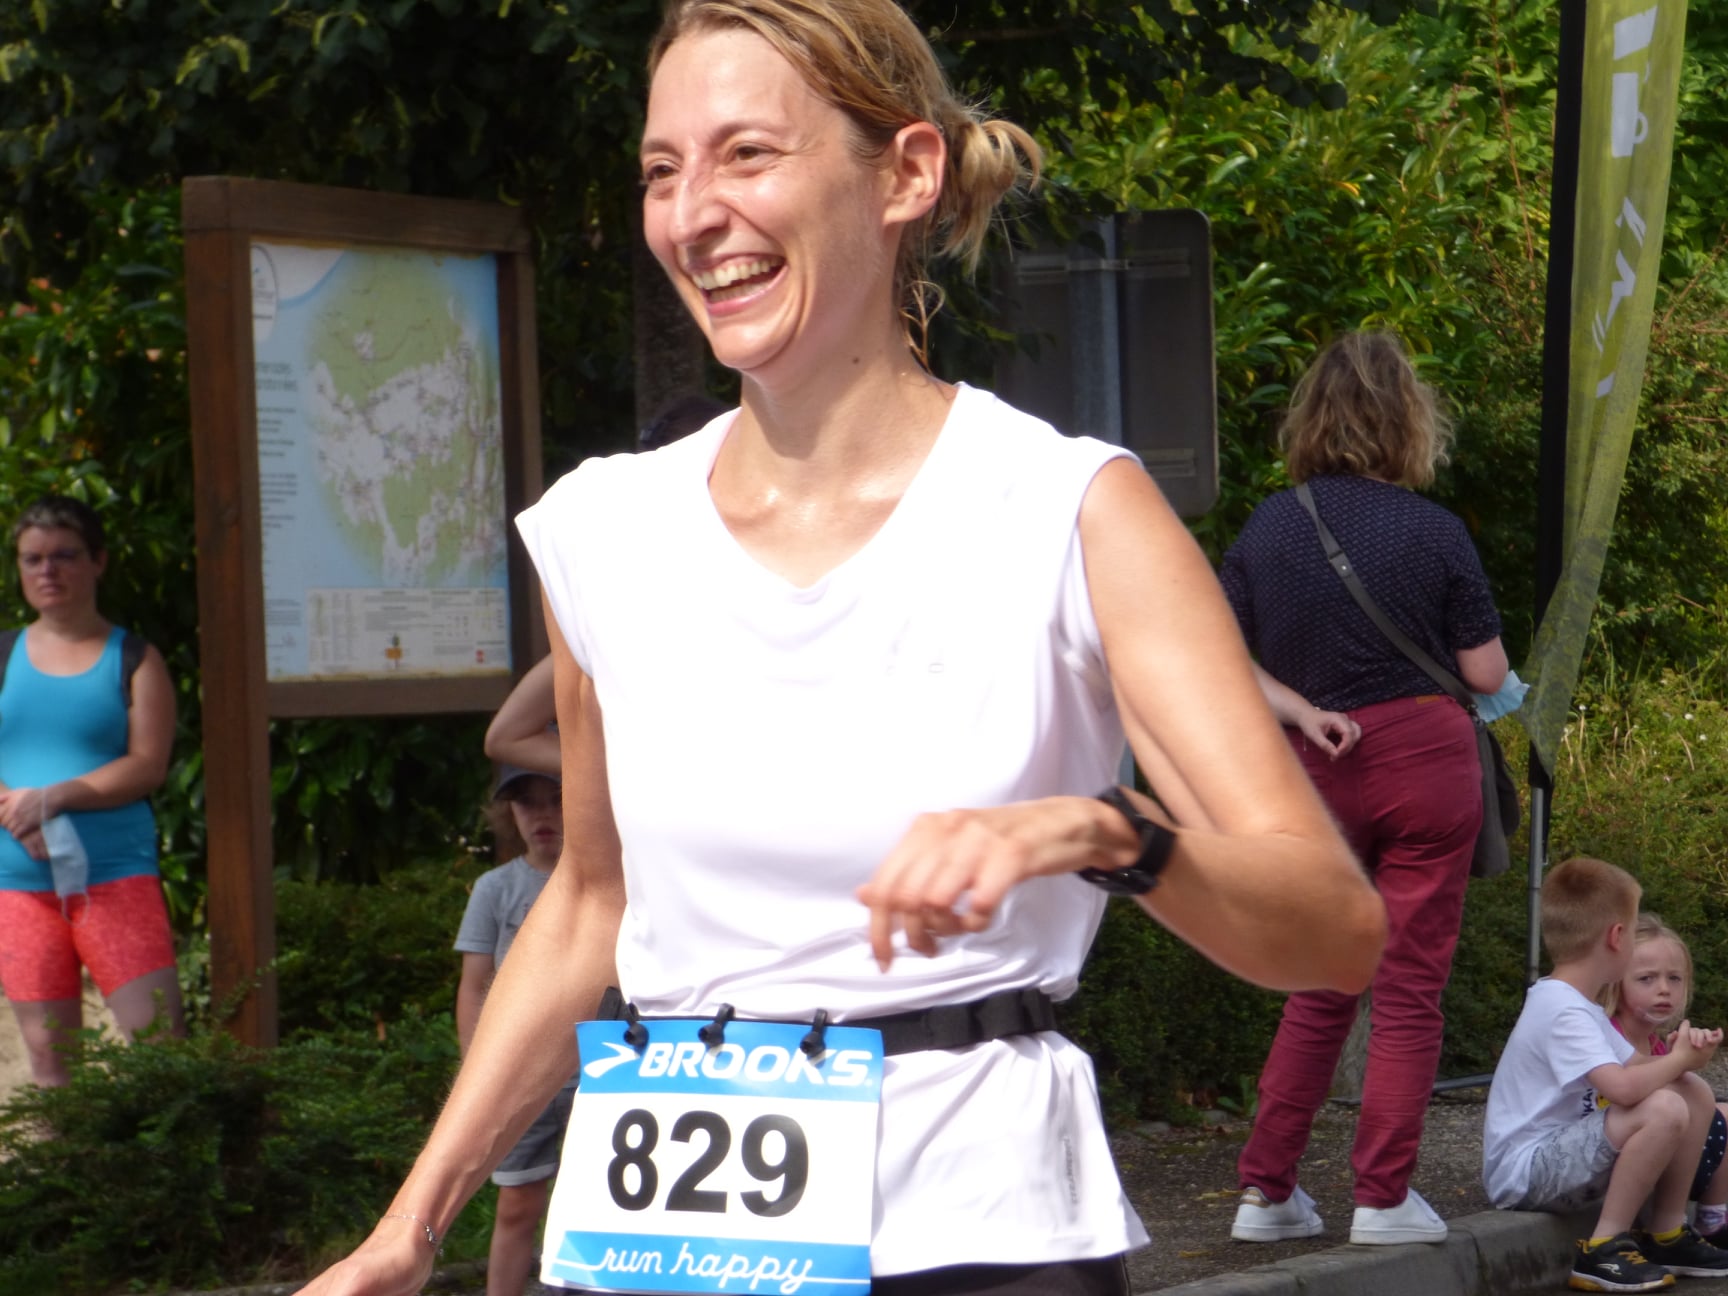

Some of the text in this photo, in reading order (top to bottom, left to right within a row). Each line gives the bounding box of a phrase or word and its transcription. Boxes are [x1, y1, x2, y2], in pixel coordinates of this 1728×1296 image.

[637, 1041, 873, 1087] BROOKS
[607, 1108, 809, 1218] 829
[594, 1241, 813, 1295] run happy
